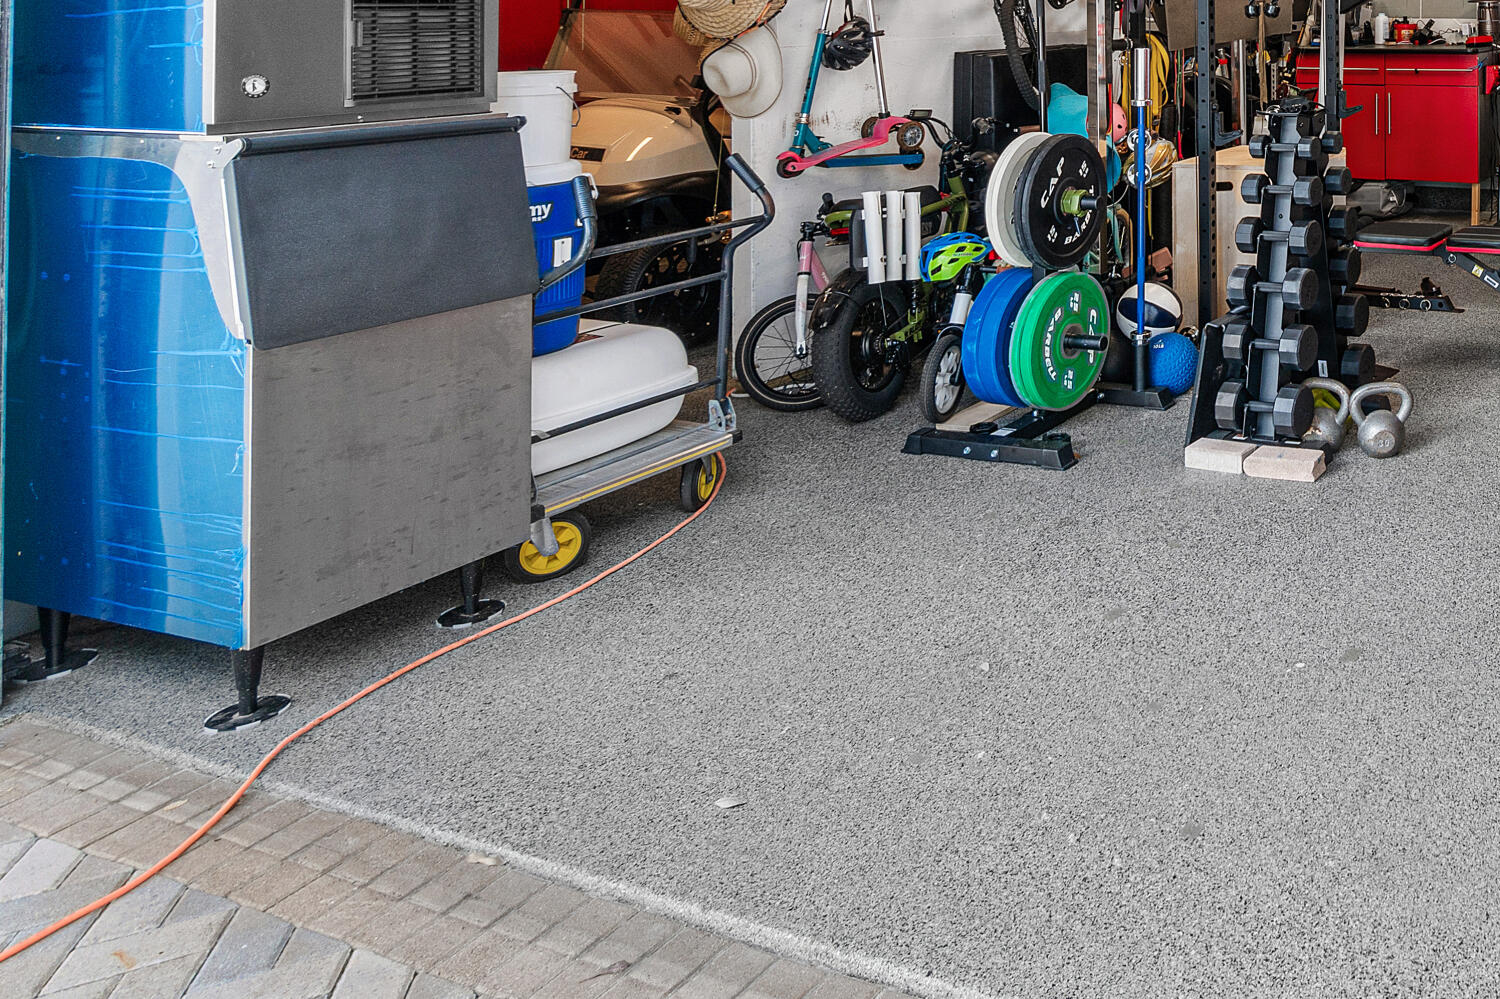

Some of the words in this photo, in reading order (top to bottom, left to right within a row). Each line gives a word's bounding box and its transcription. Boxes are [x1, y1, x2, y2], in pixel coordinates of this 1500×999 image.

[570, 147, 588, 159] Car
[1041, 157, 1064, 208] CAP
[1044, 307, 1062, 381] BARBELL
[1378, 439, 1391, 448] 30
